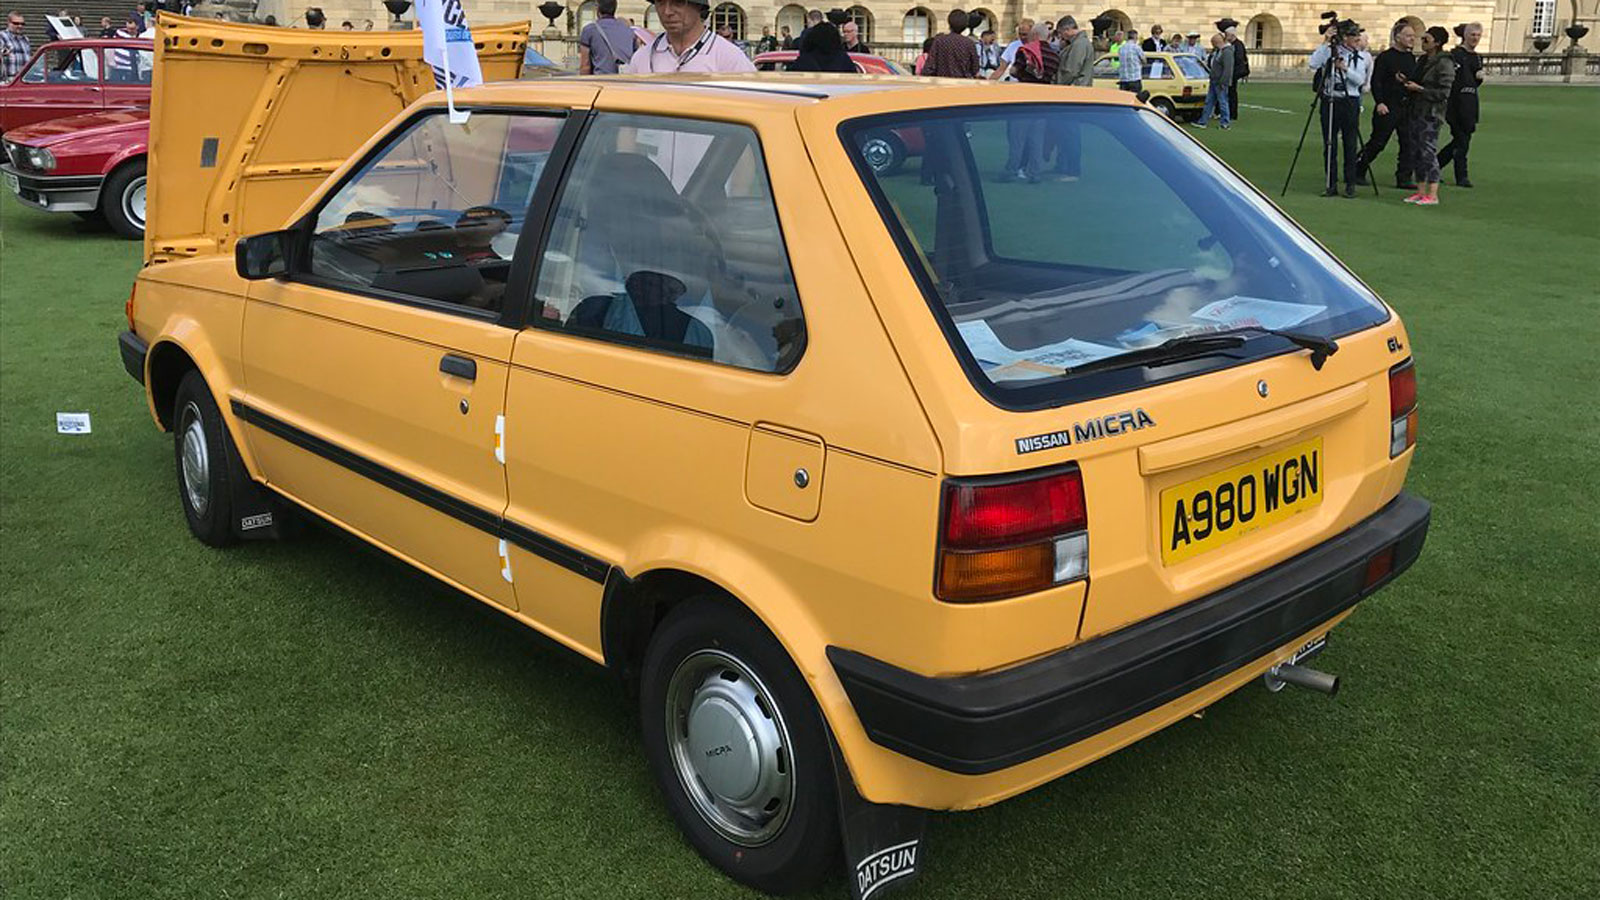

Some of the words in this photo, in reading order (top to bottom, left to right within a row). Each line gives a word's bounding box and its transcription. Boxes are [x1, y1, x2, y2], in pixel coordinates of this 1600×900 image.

[1387, 336, 1403, 353] GL
[1017, 431, 1069, 453] NISSAN
[1073, 408, 1156, 443] MICRA
[1171, 475, 1257, 551] A980
[1263, 450, 1318, 513] WGN
[857, 846, 917, 894] DATSUN
